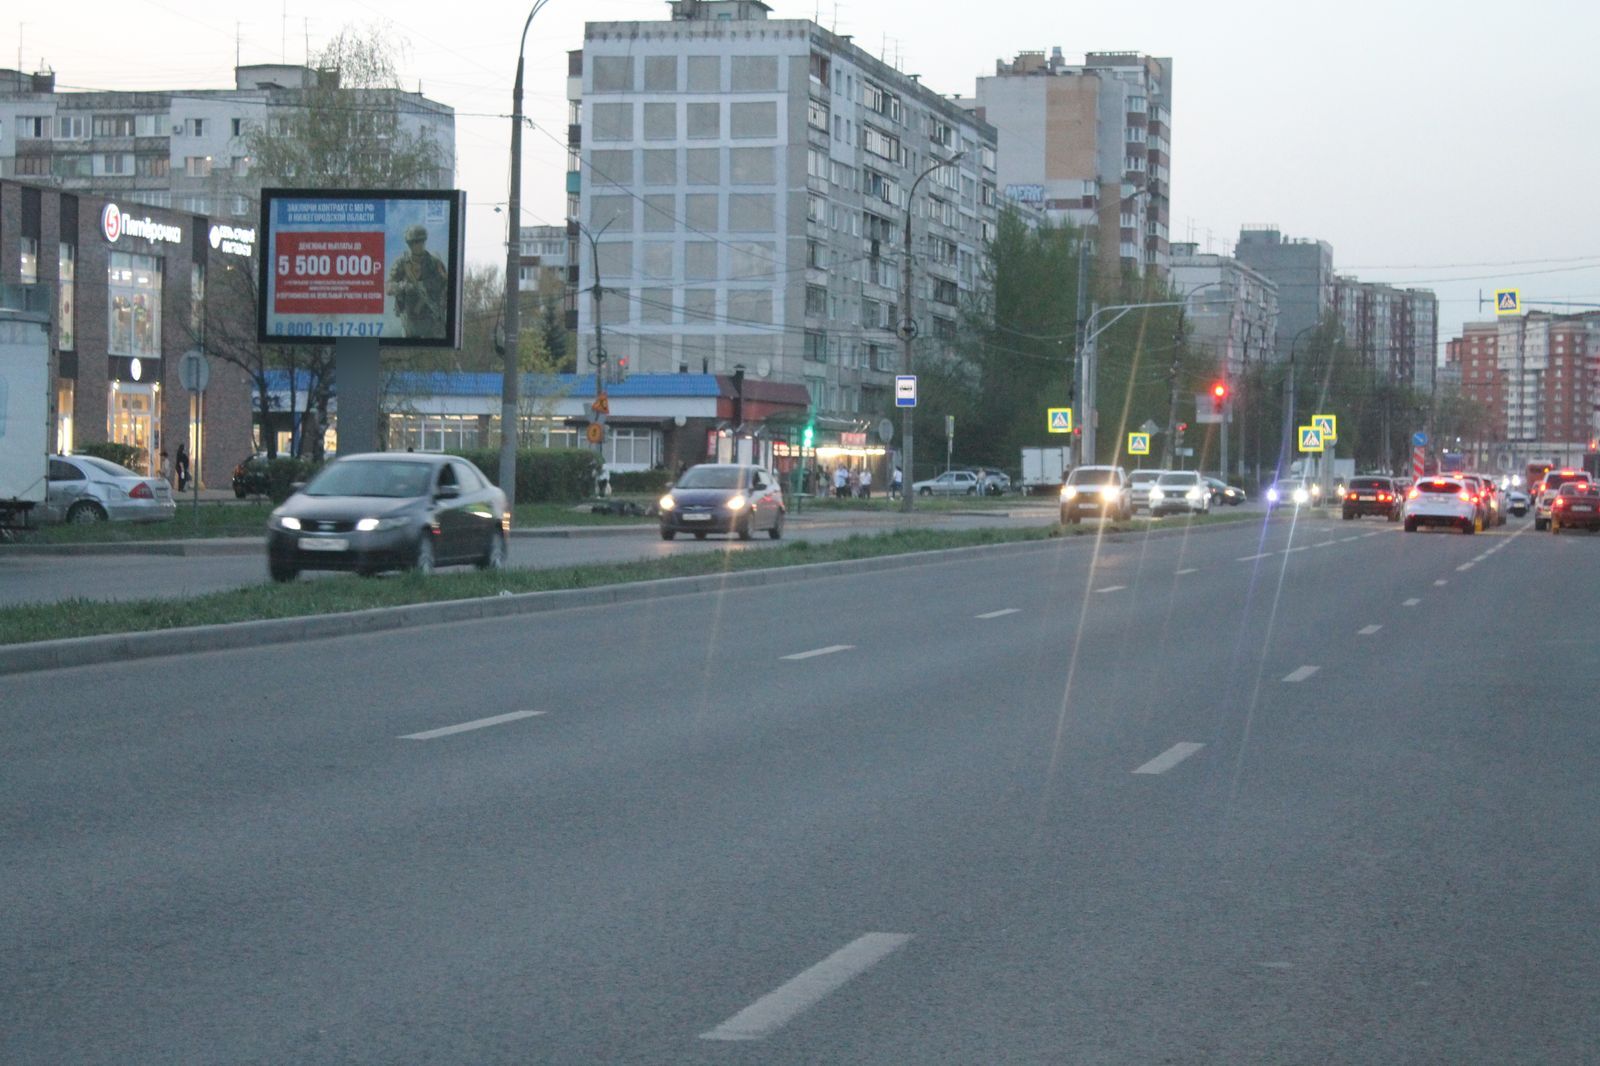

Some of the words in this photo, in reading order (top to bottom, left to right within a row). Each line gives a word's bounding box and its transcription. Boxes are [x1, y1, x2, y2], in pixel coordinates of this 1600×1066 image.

[317, 203, 348, 212] КОНТРАКТ
[348, 203, 353, 212] С
[354, 203, 364, 212] МО
[364, 203, 375, 212] РФ
[293, 212, 346, 222] НИЖЕГОРОДСКОЙ
[346, 212, 375, 222] ОБЛАСТИ
[121, 213, 181, 244] Пятёрочка
[278, 255, 289, 276] 5
[295, 255, 331, 276] 500
[275, 321, 284, 336] 8
